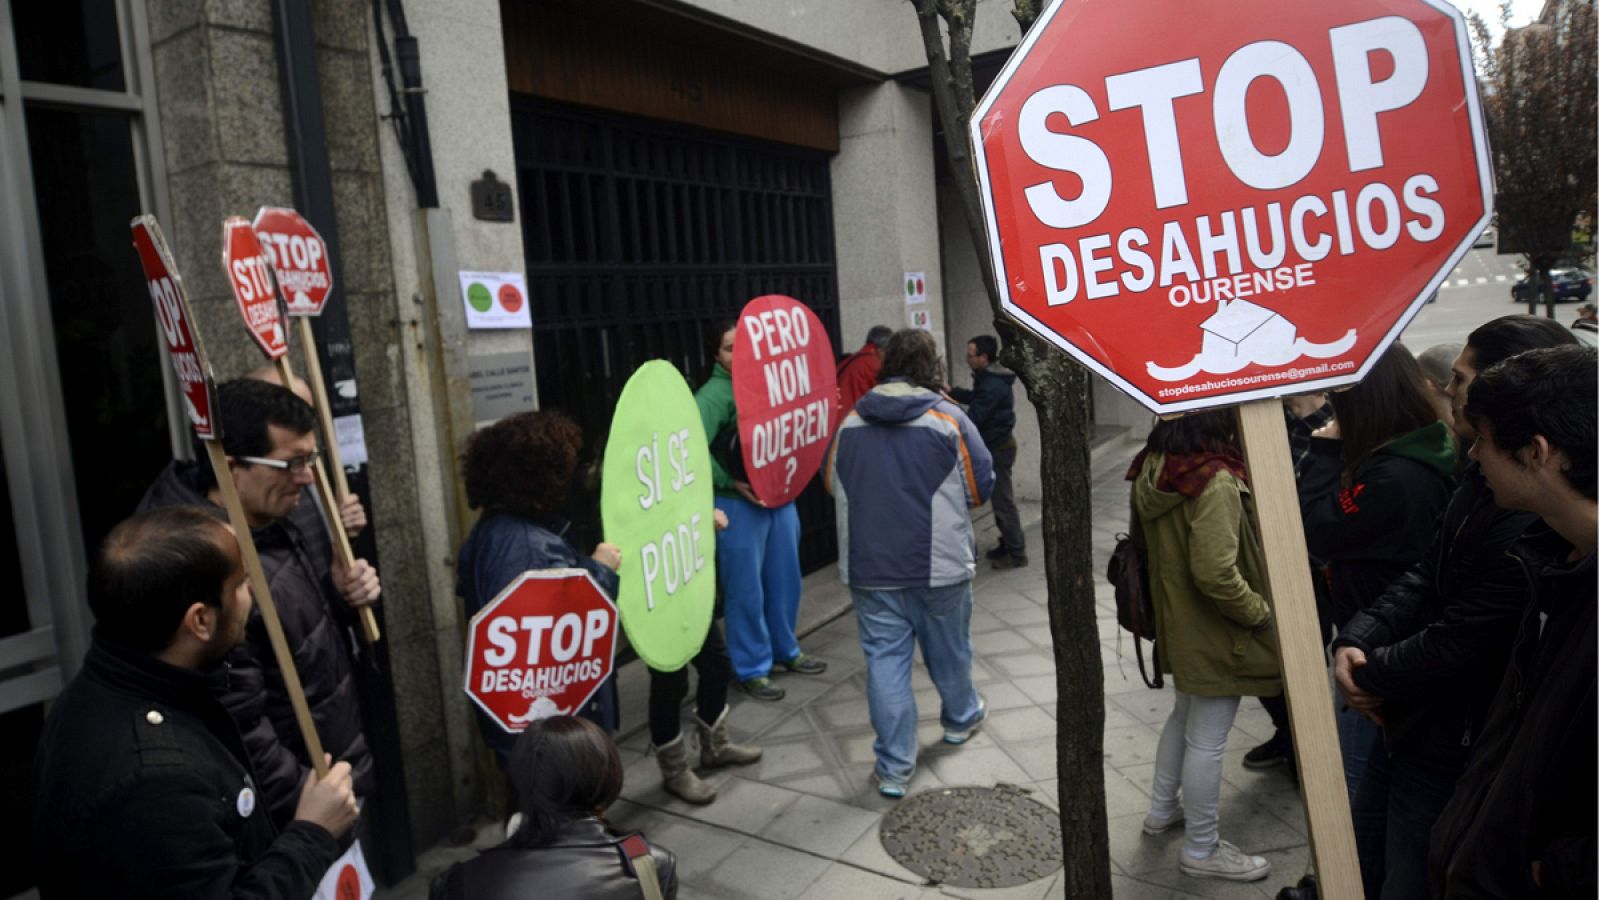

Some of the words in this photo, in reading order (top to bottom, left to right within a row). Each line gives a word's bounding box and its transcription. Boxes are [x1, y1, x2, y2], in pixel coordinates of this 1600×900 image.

[1017, 15, 1430, 230] STOP
[484, 191, 505, 209] 45
[258, 231, 322, 271] STOP
[1038, 172, 1446, 307] DESAHUCIOS
[232, 254, 273, 302] STO
[1167, 263, 1316, 308] OURENSE
[744, 306, 811, 361] PERO
[764, 353, 812, 408] NON
[1158, 360, 1355, 398] stopdesahuciosourense@gmail.com
[667, 427, 695, 493] SE
[751, 397, 830, 470] QUEREN
[784, 455, 798, 496] ?
[640, 511, 705, 612] PODE
[483, 608, 610, 668] STOP
[480, 658, 603, 694] DESAHUCIOS
